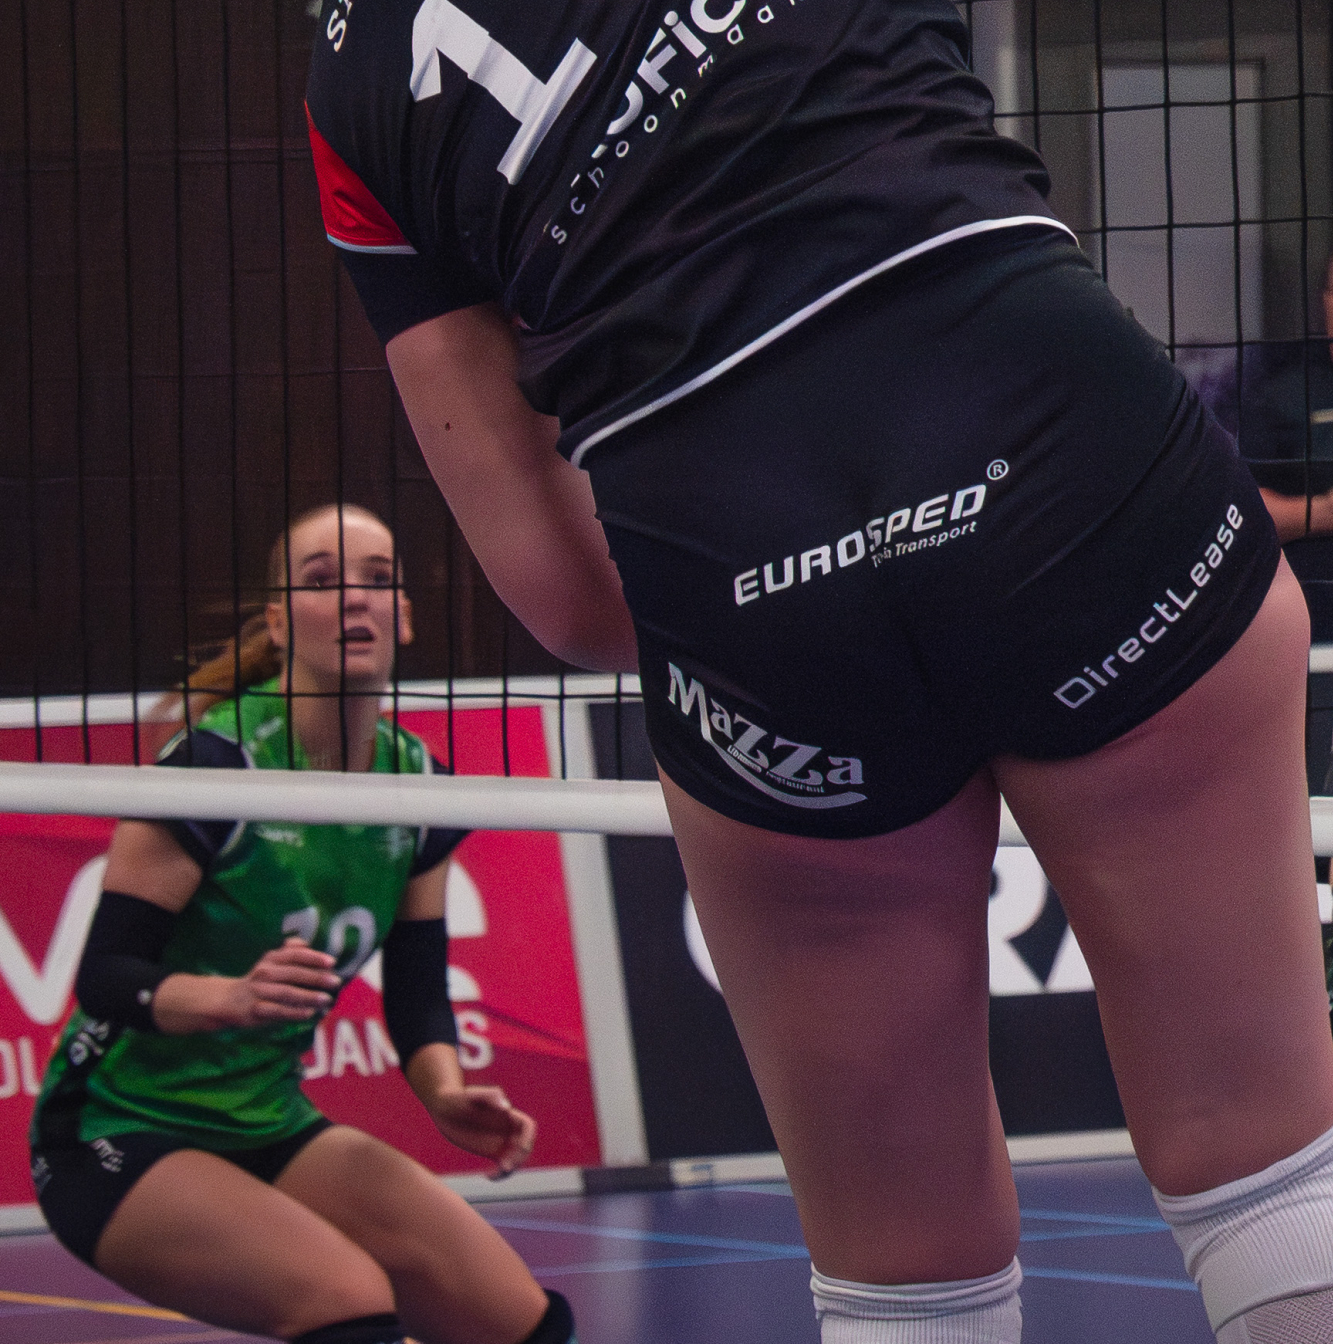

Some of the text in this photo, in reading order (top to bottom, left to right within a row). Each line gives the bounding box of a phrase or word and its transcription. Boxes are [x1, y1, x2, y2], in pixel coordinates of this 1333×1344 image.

[733, 483, 987, 607] EUROSPED
[895, 519, 978, 557] Transport
[1053, 503, 1244, 710] DirectLease
